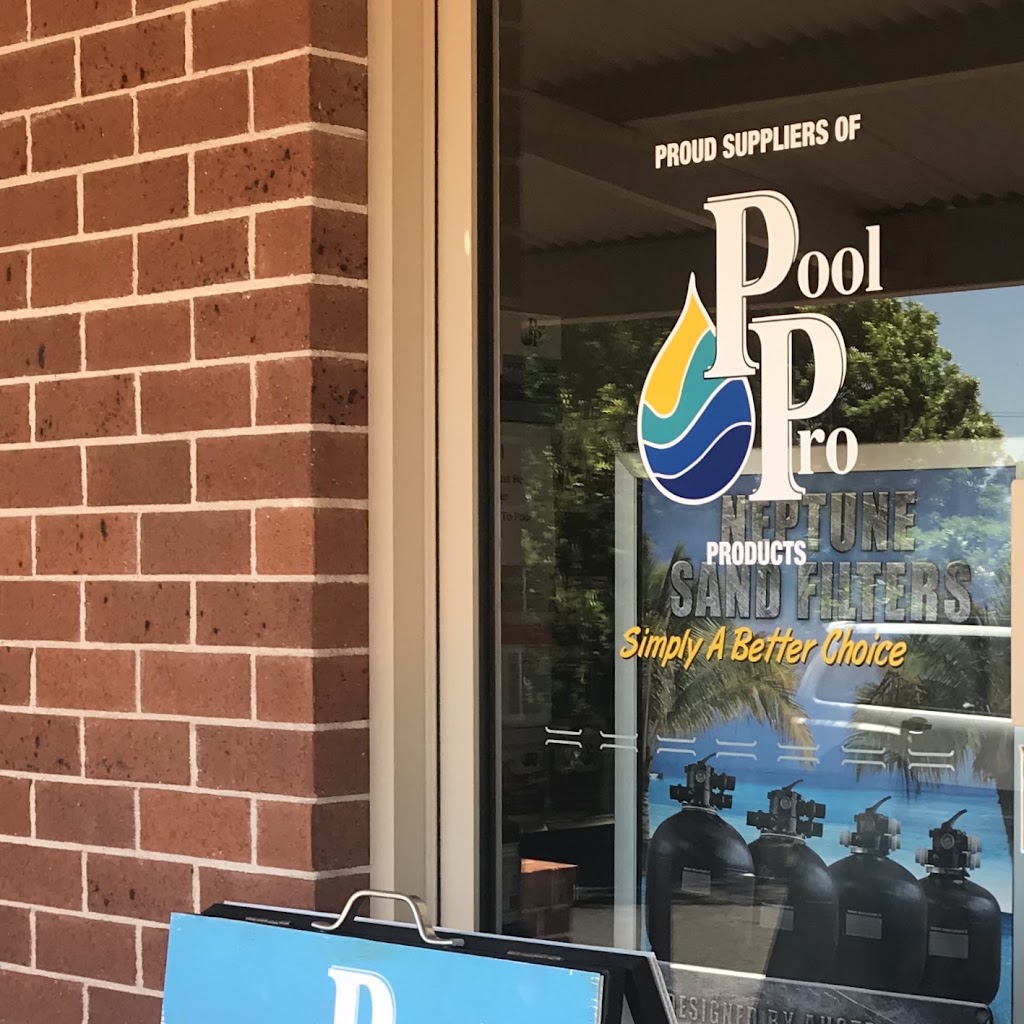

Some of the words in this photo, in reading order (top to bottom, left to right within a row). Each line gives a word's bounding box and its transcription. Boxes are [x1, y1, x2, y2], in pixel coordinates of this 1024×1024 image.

[655, 136, 717, 169] PROUD
[722, 118, 829, 160] SUPPLIERS
[834, 113, 862, 143] OF
[703, 189, 883, 379] Pool
[748, 313, 858, 502] Pro
[720, 490, 917, 552] NEPTUNE
[706, 540, 807, 566] PRODUCTS
[669, 560, 783, 621] SAND
[796, 560, 972, 624] FILTERS
[619, 625, 704, 670] Simply
[707, 626, 728, 661] A
[731, 627, 818, 665] Better
[820, 631, 908, 669] Choice
